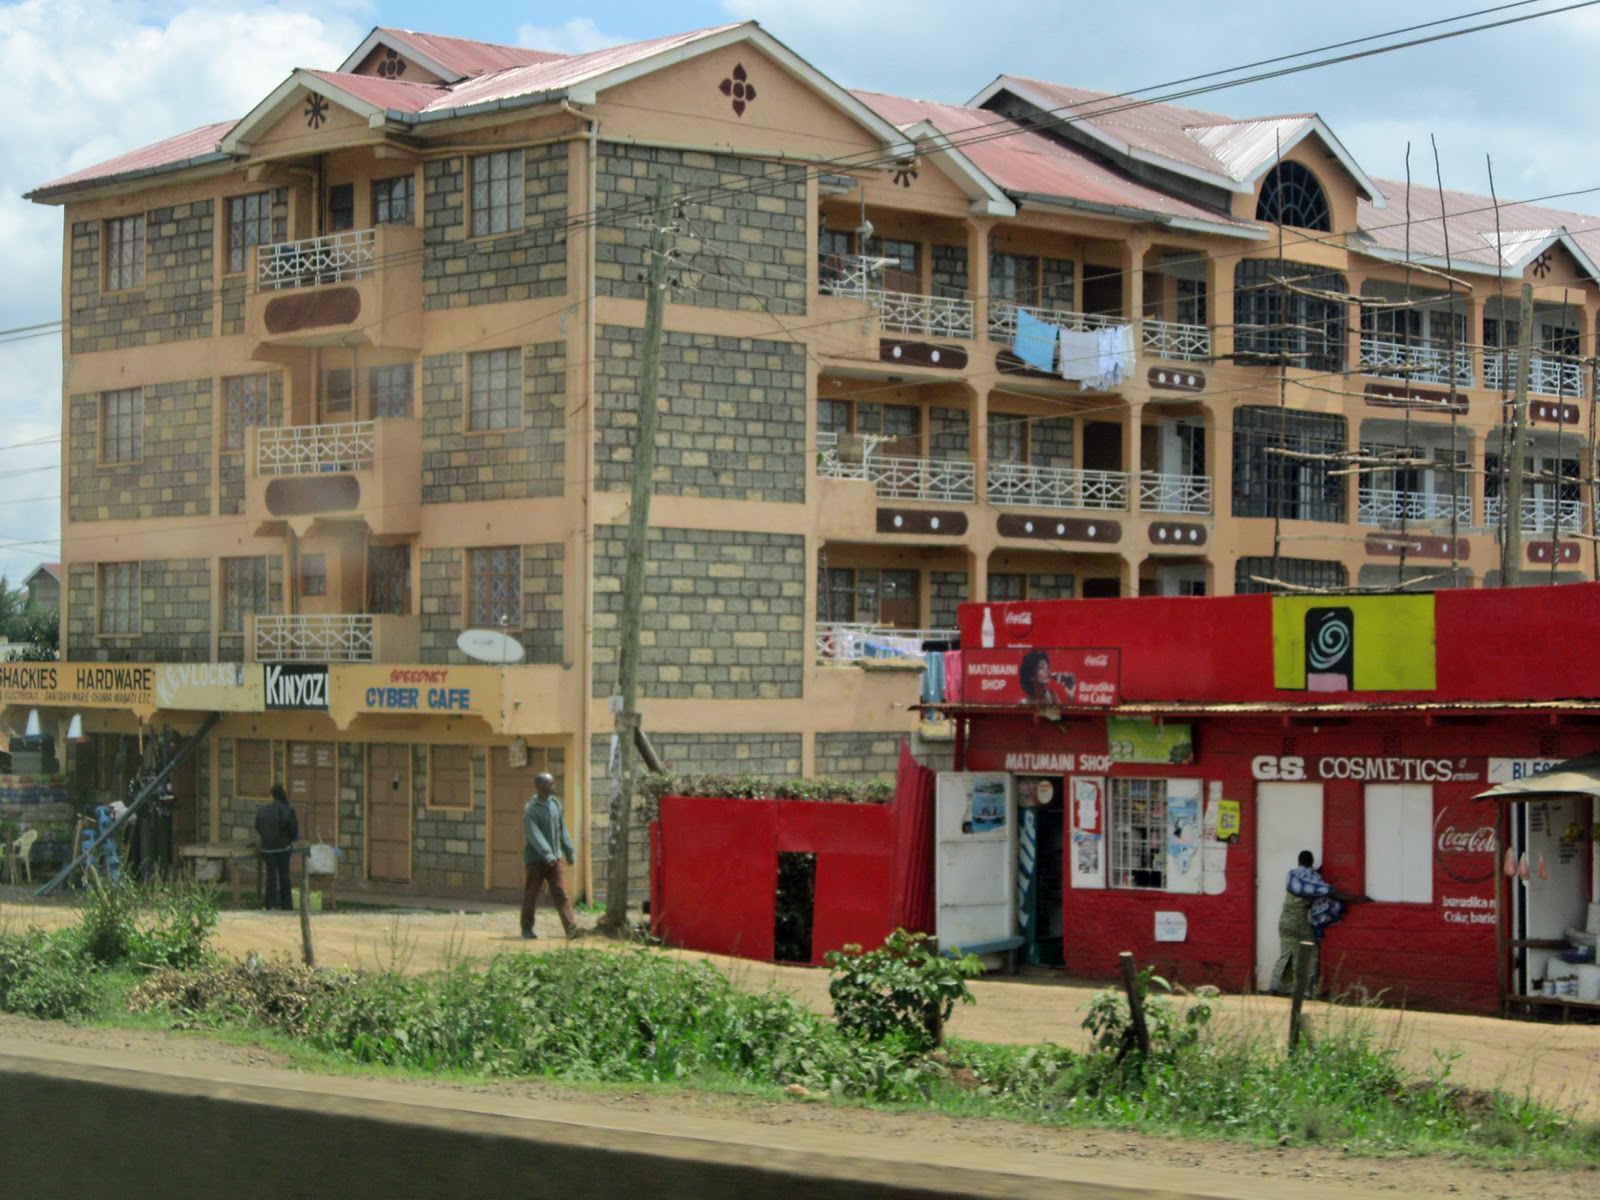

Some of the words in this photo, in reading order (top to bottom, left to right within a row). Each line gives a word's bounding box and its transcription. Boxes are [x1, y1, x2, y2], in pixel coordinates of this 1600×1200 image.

[76, 668, 152, 690] HARDWARE
[968, 664, 1019, 676] MATUMAINI
[266, 665, 329, 706] KINYOZI
[981, 679, 1007, 691] SHOP
[365, 688, 420, 709] CYBER
[428, 688, 471, 710] CAFE
[1090, 692, 1113, 705] Coke
[1005, 753, 1075, 771] MATUMAINI
[1079, 754, 1115, 772] SHOP
[1319, 757, 1453, 782] COSMETICS
